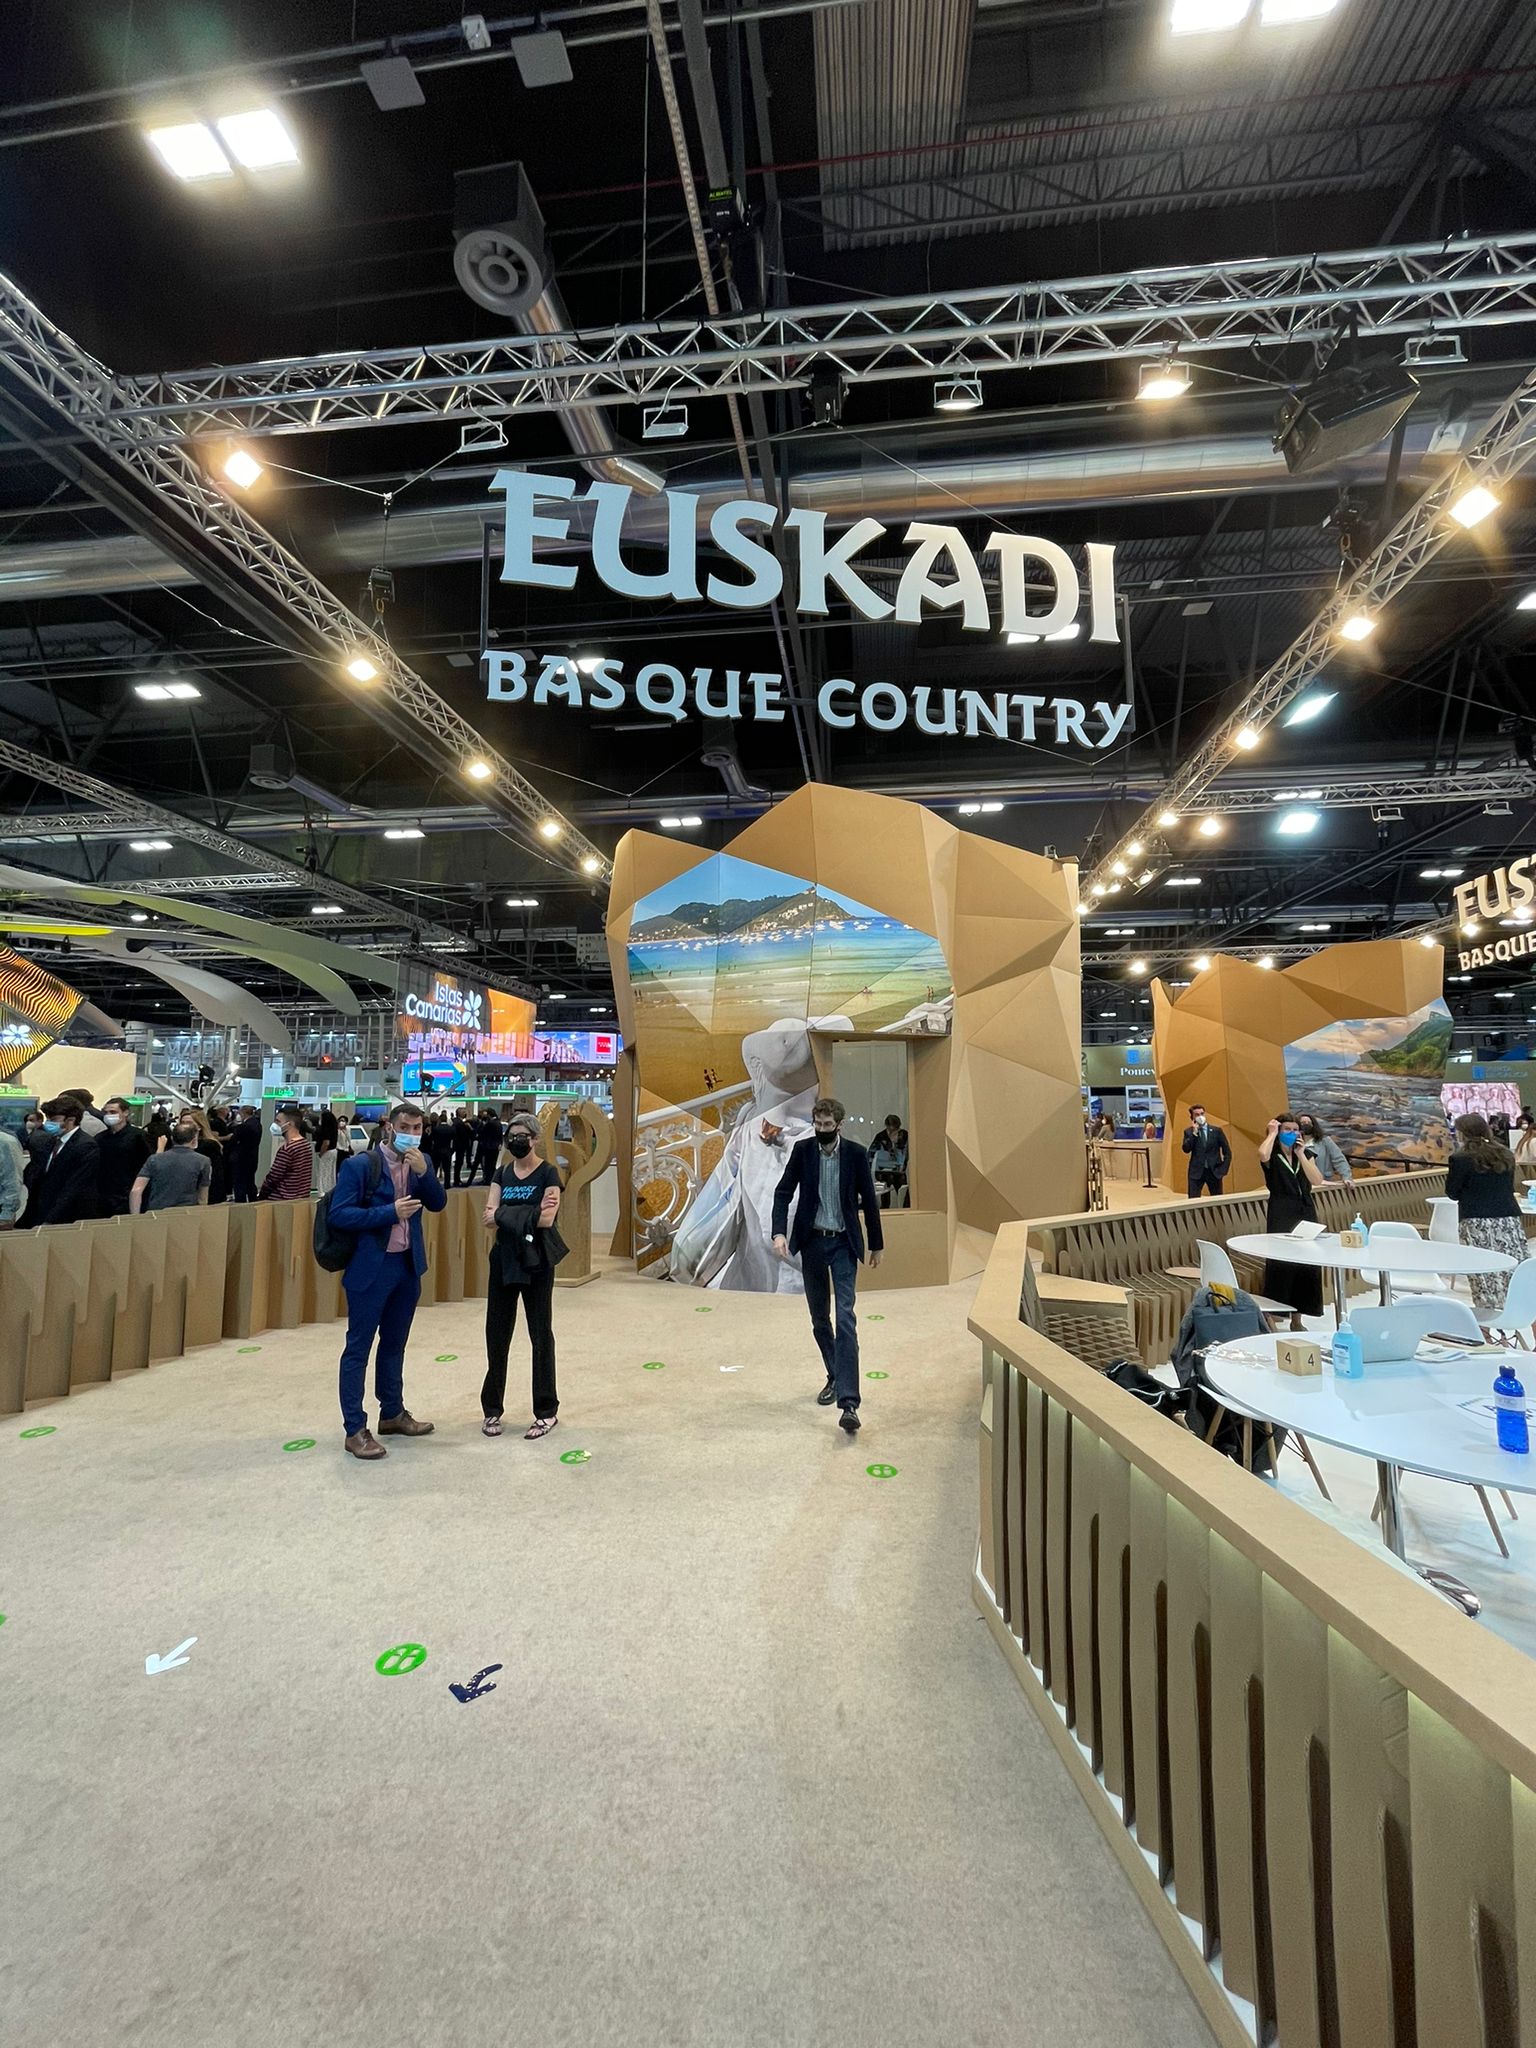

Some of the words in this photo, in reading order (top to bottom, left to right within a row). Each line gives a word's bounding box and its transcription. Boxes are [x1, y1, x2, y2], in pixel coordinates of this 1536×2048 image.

[488, 469, 1120, 644] EUSKADI
[481, 649, 787, 723] BASQUE
[817, 678, 1133, 749] COUNTRY
[1453, 853, 1536, 928] EUS
[1458, 930, 1536, 971] BASQUE
[405, 993, 463, 1027] Canarias
[435, 981, 463, 1006] Islas
[1284, 1351, 1292, 1365] 4
[1307, 1352, 1315, 1366] 4
